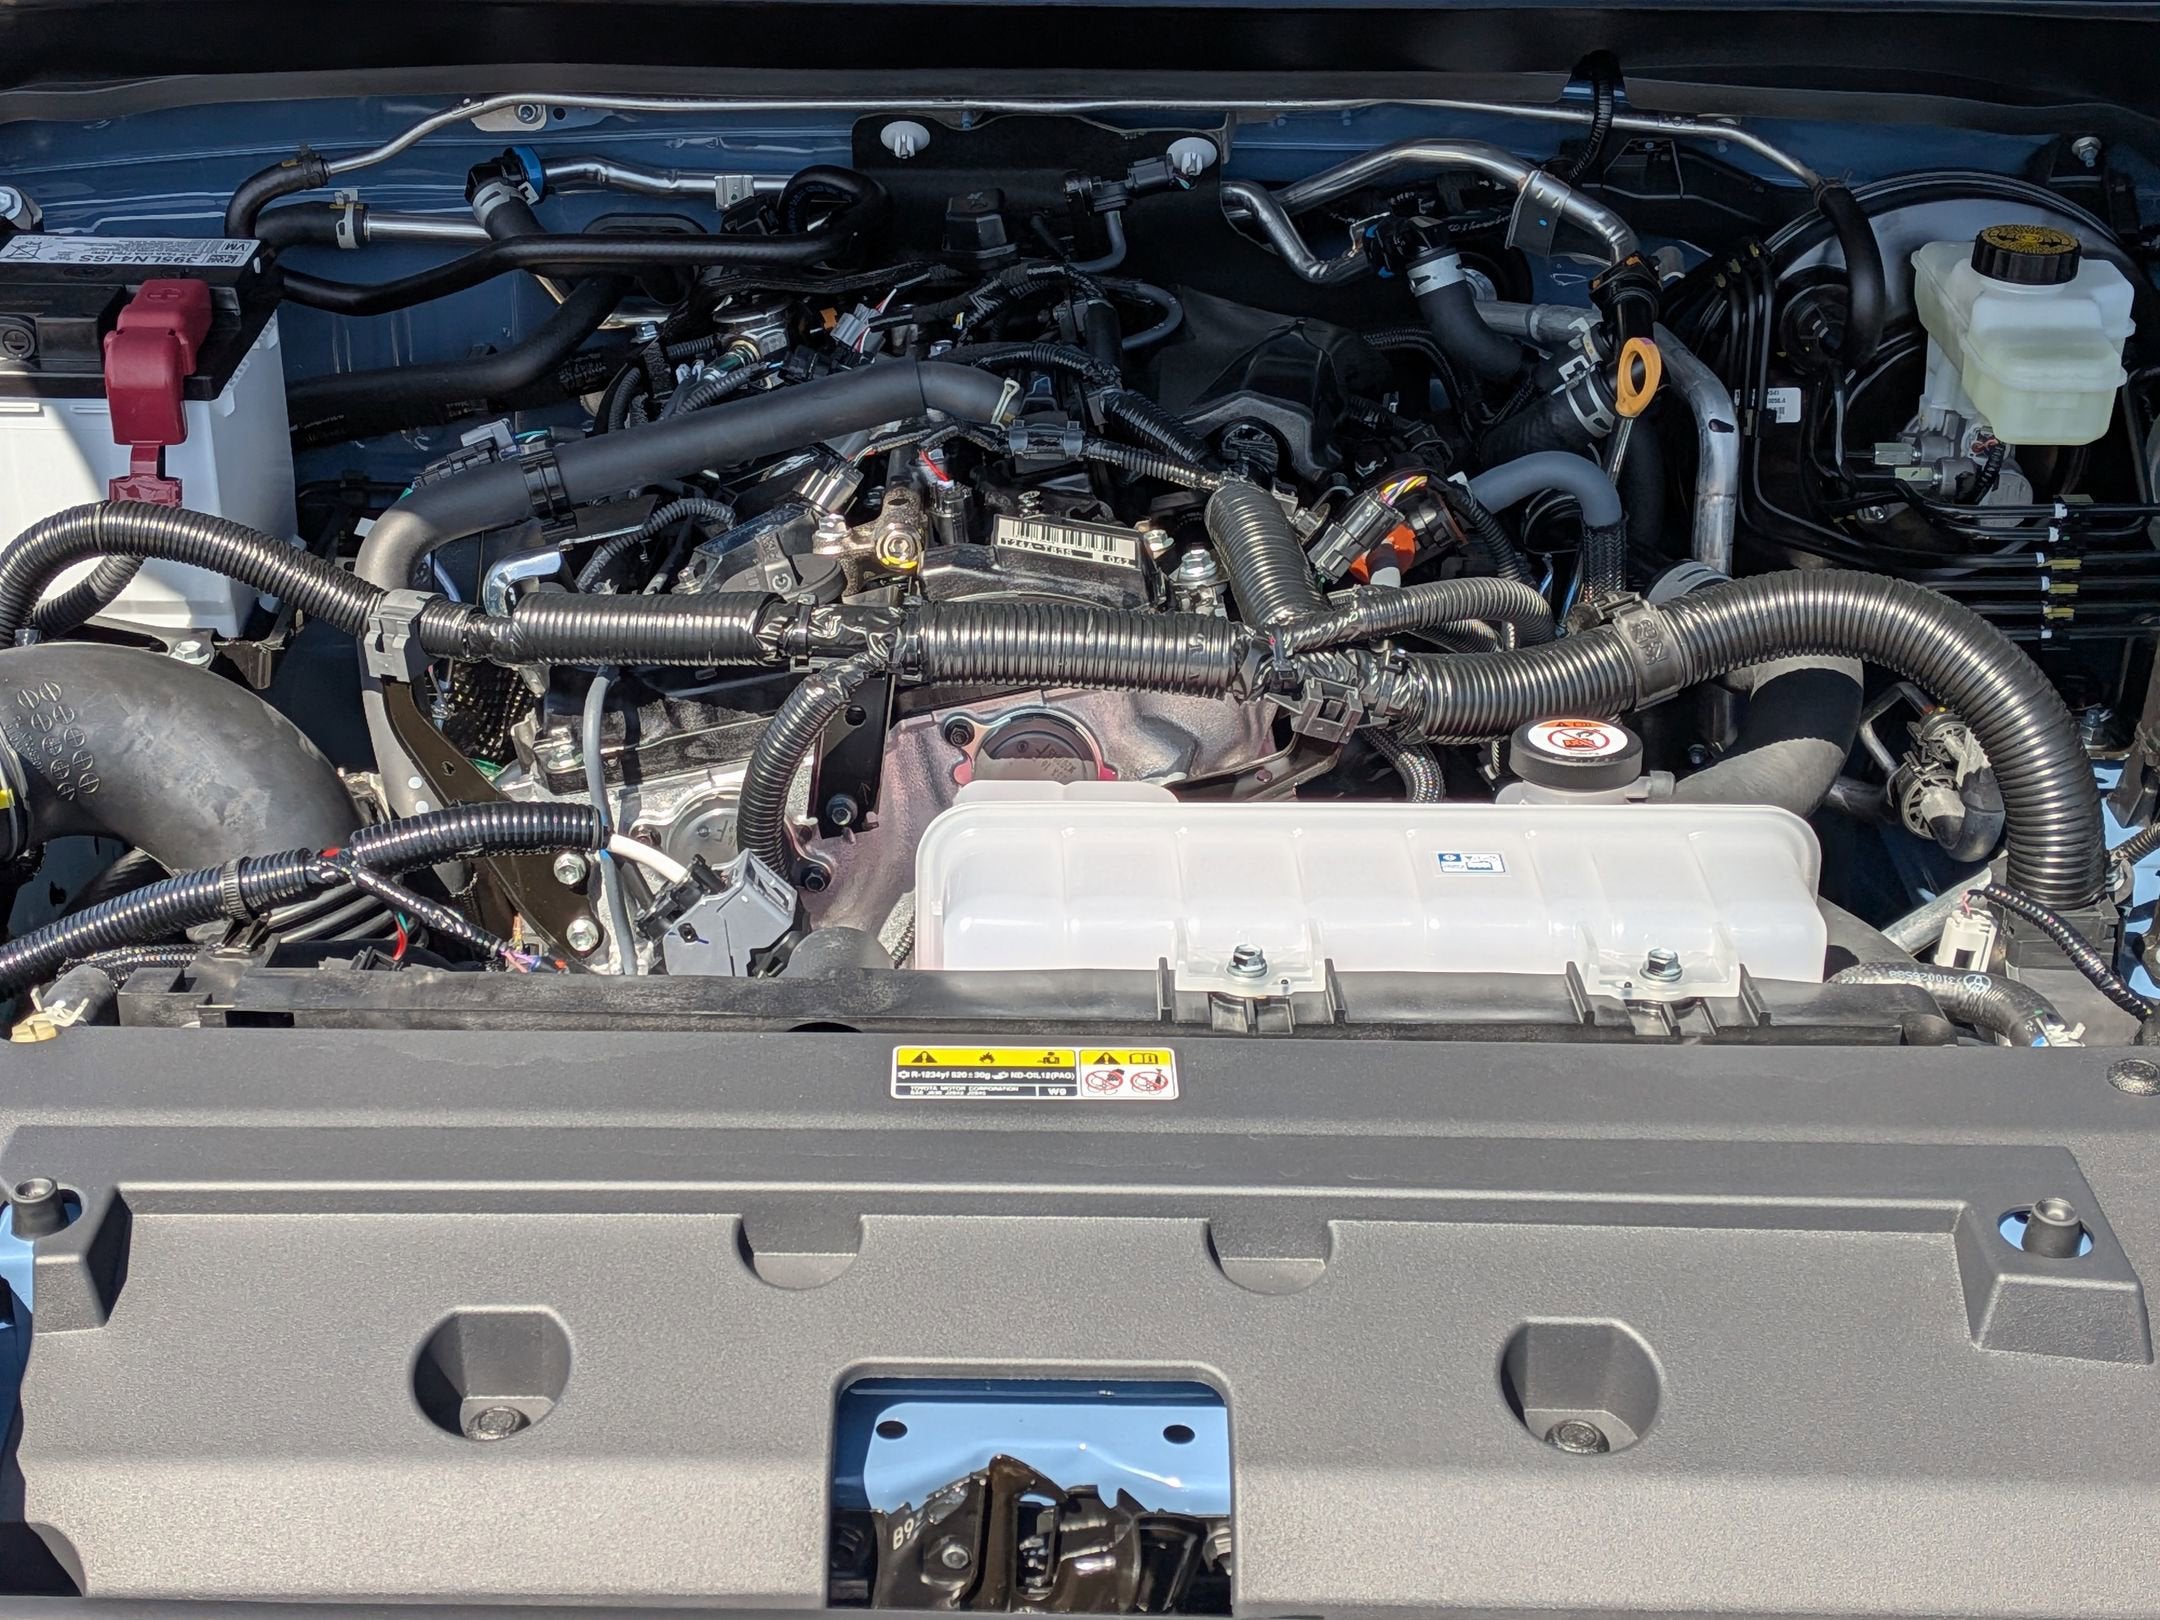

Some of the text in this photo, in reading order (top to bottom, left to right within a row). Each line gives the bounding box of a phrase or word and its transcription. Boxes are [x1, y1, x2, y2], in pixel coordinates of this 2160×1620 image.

[225, 242, 246, 250] VM
[79, 255, 199, 264] 395LN4-ISS
[892, 1517, 914, 1551] B9
